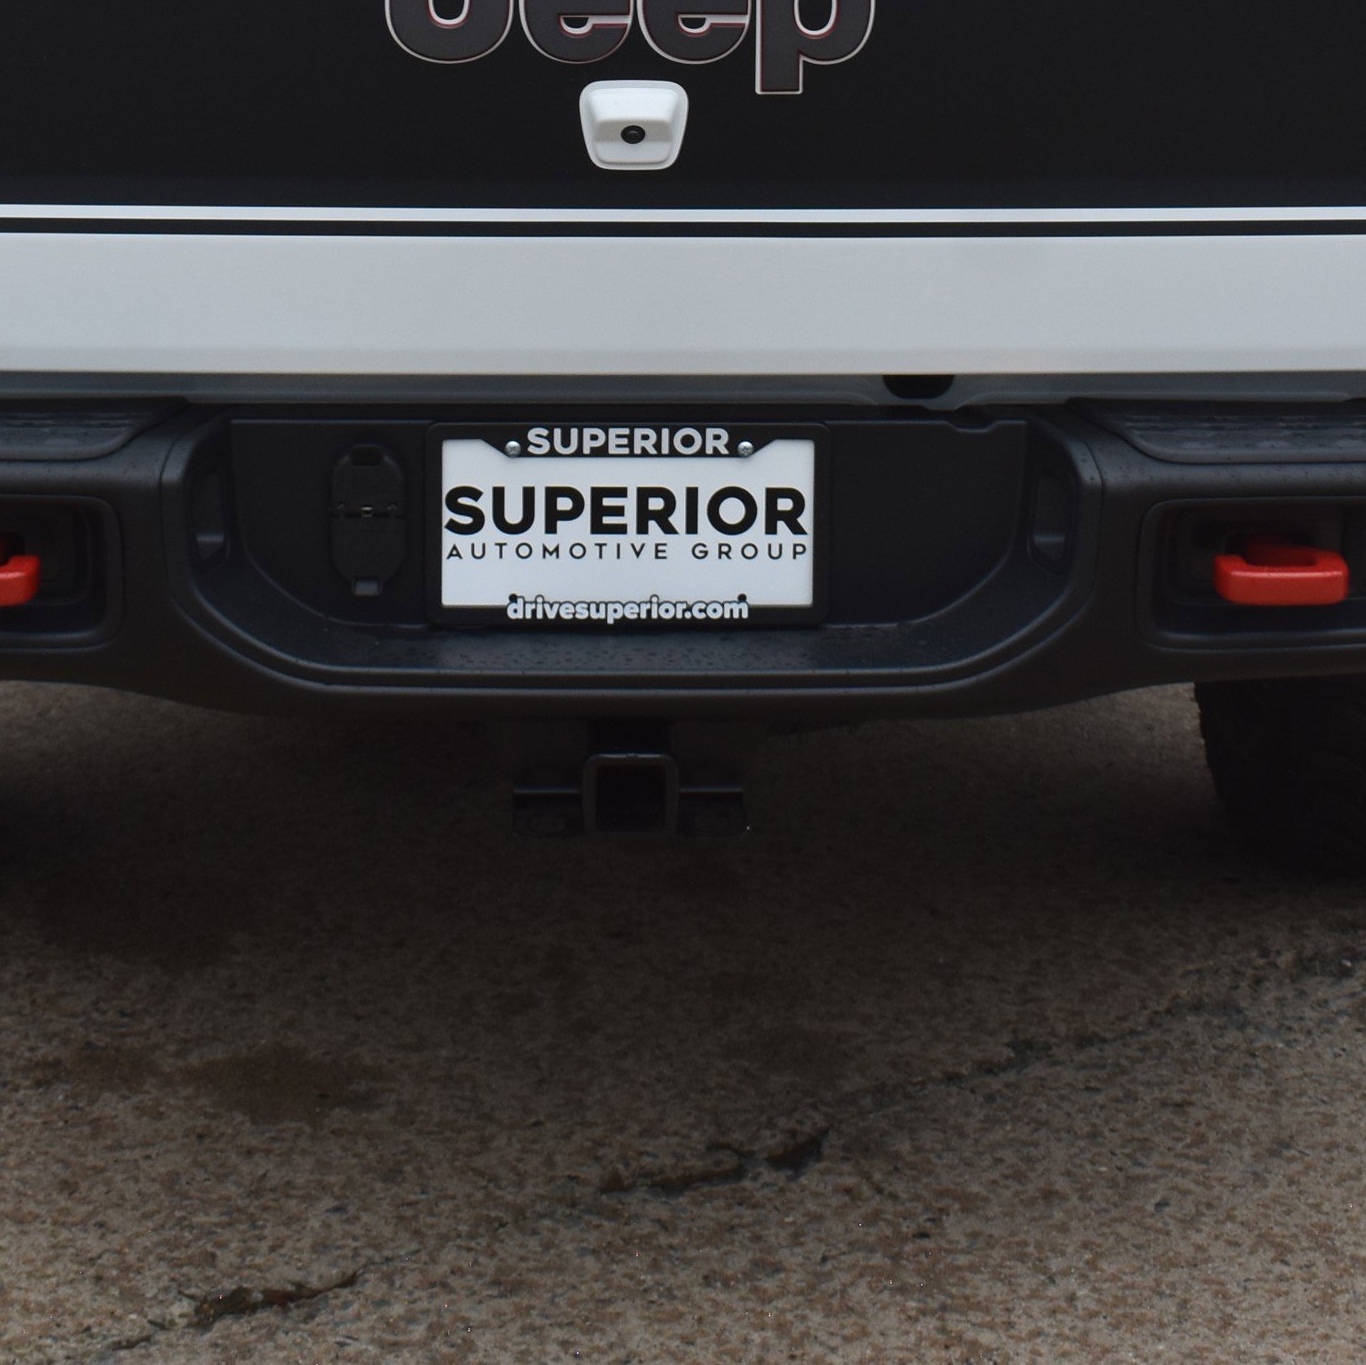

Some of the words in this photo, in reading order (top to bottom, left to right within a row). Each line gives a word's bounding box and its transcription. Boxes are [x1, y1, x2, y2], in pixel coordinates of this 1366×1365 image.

[526, 427, 729, 455] SUPERIOR
[444, 485, 808, 536] SUPERIOR
[446, 542, 669, 561] AUTOMOTIVE
[691, 542, 808, 561] GROUP
[507, 593, 749, 625] drivesuperior.com
